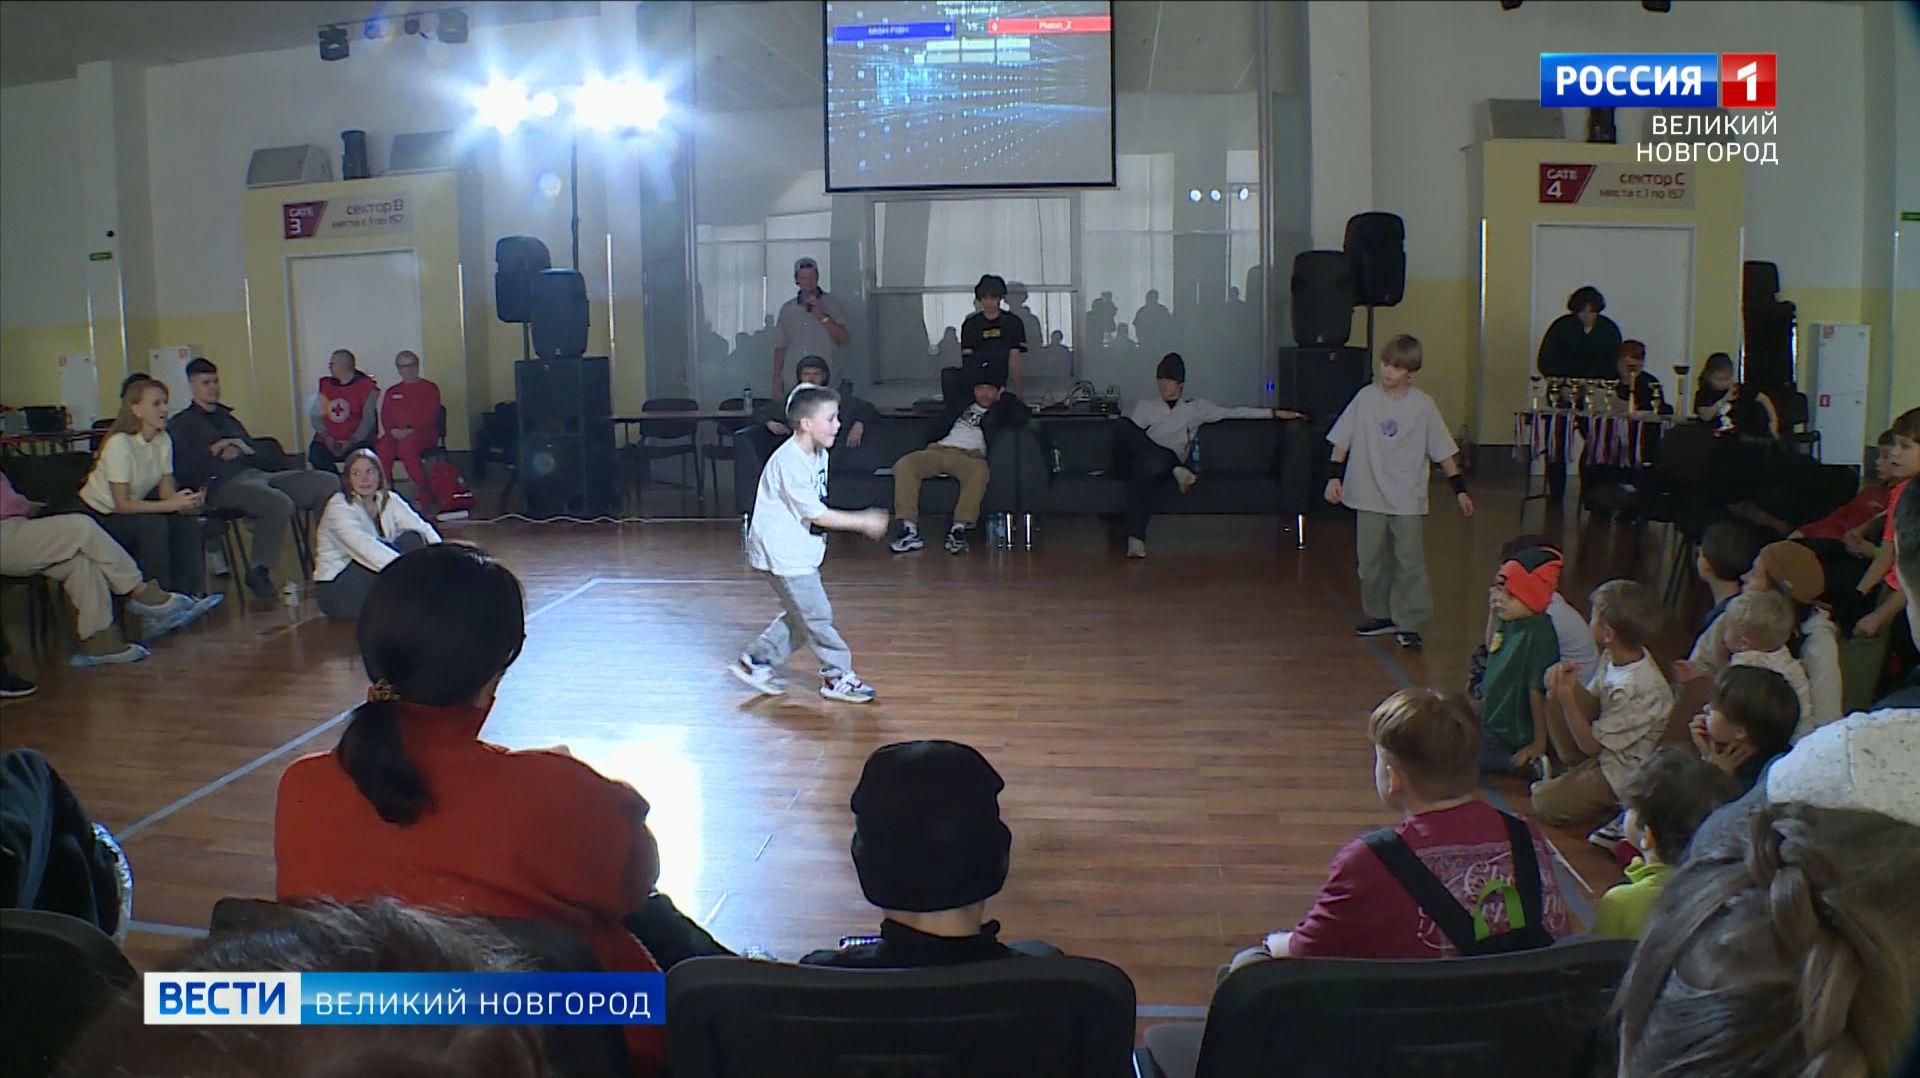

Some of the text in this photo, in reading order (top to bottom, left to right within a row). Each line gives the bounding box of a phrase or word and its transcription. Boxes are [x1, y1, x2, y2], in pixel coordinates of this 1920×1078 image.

[1547, 169, 1577, 180] GATE
[1619, 172, 1672, 187] сектор
[1546, 180, 1563, 198] 4
[289, 207, 315, 217] GATE
[346, 201, 392, 216] сектор
[289, 218, 301, 234] 3
